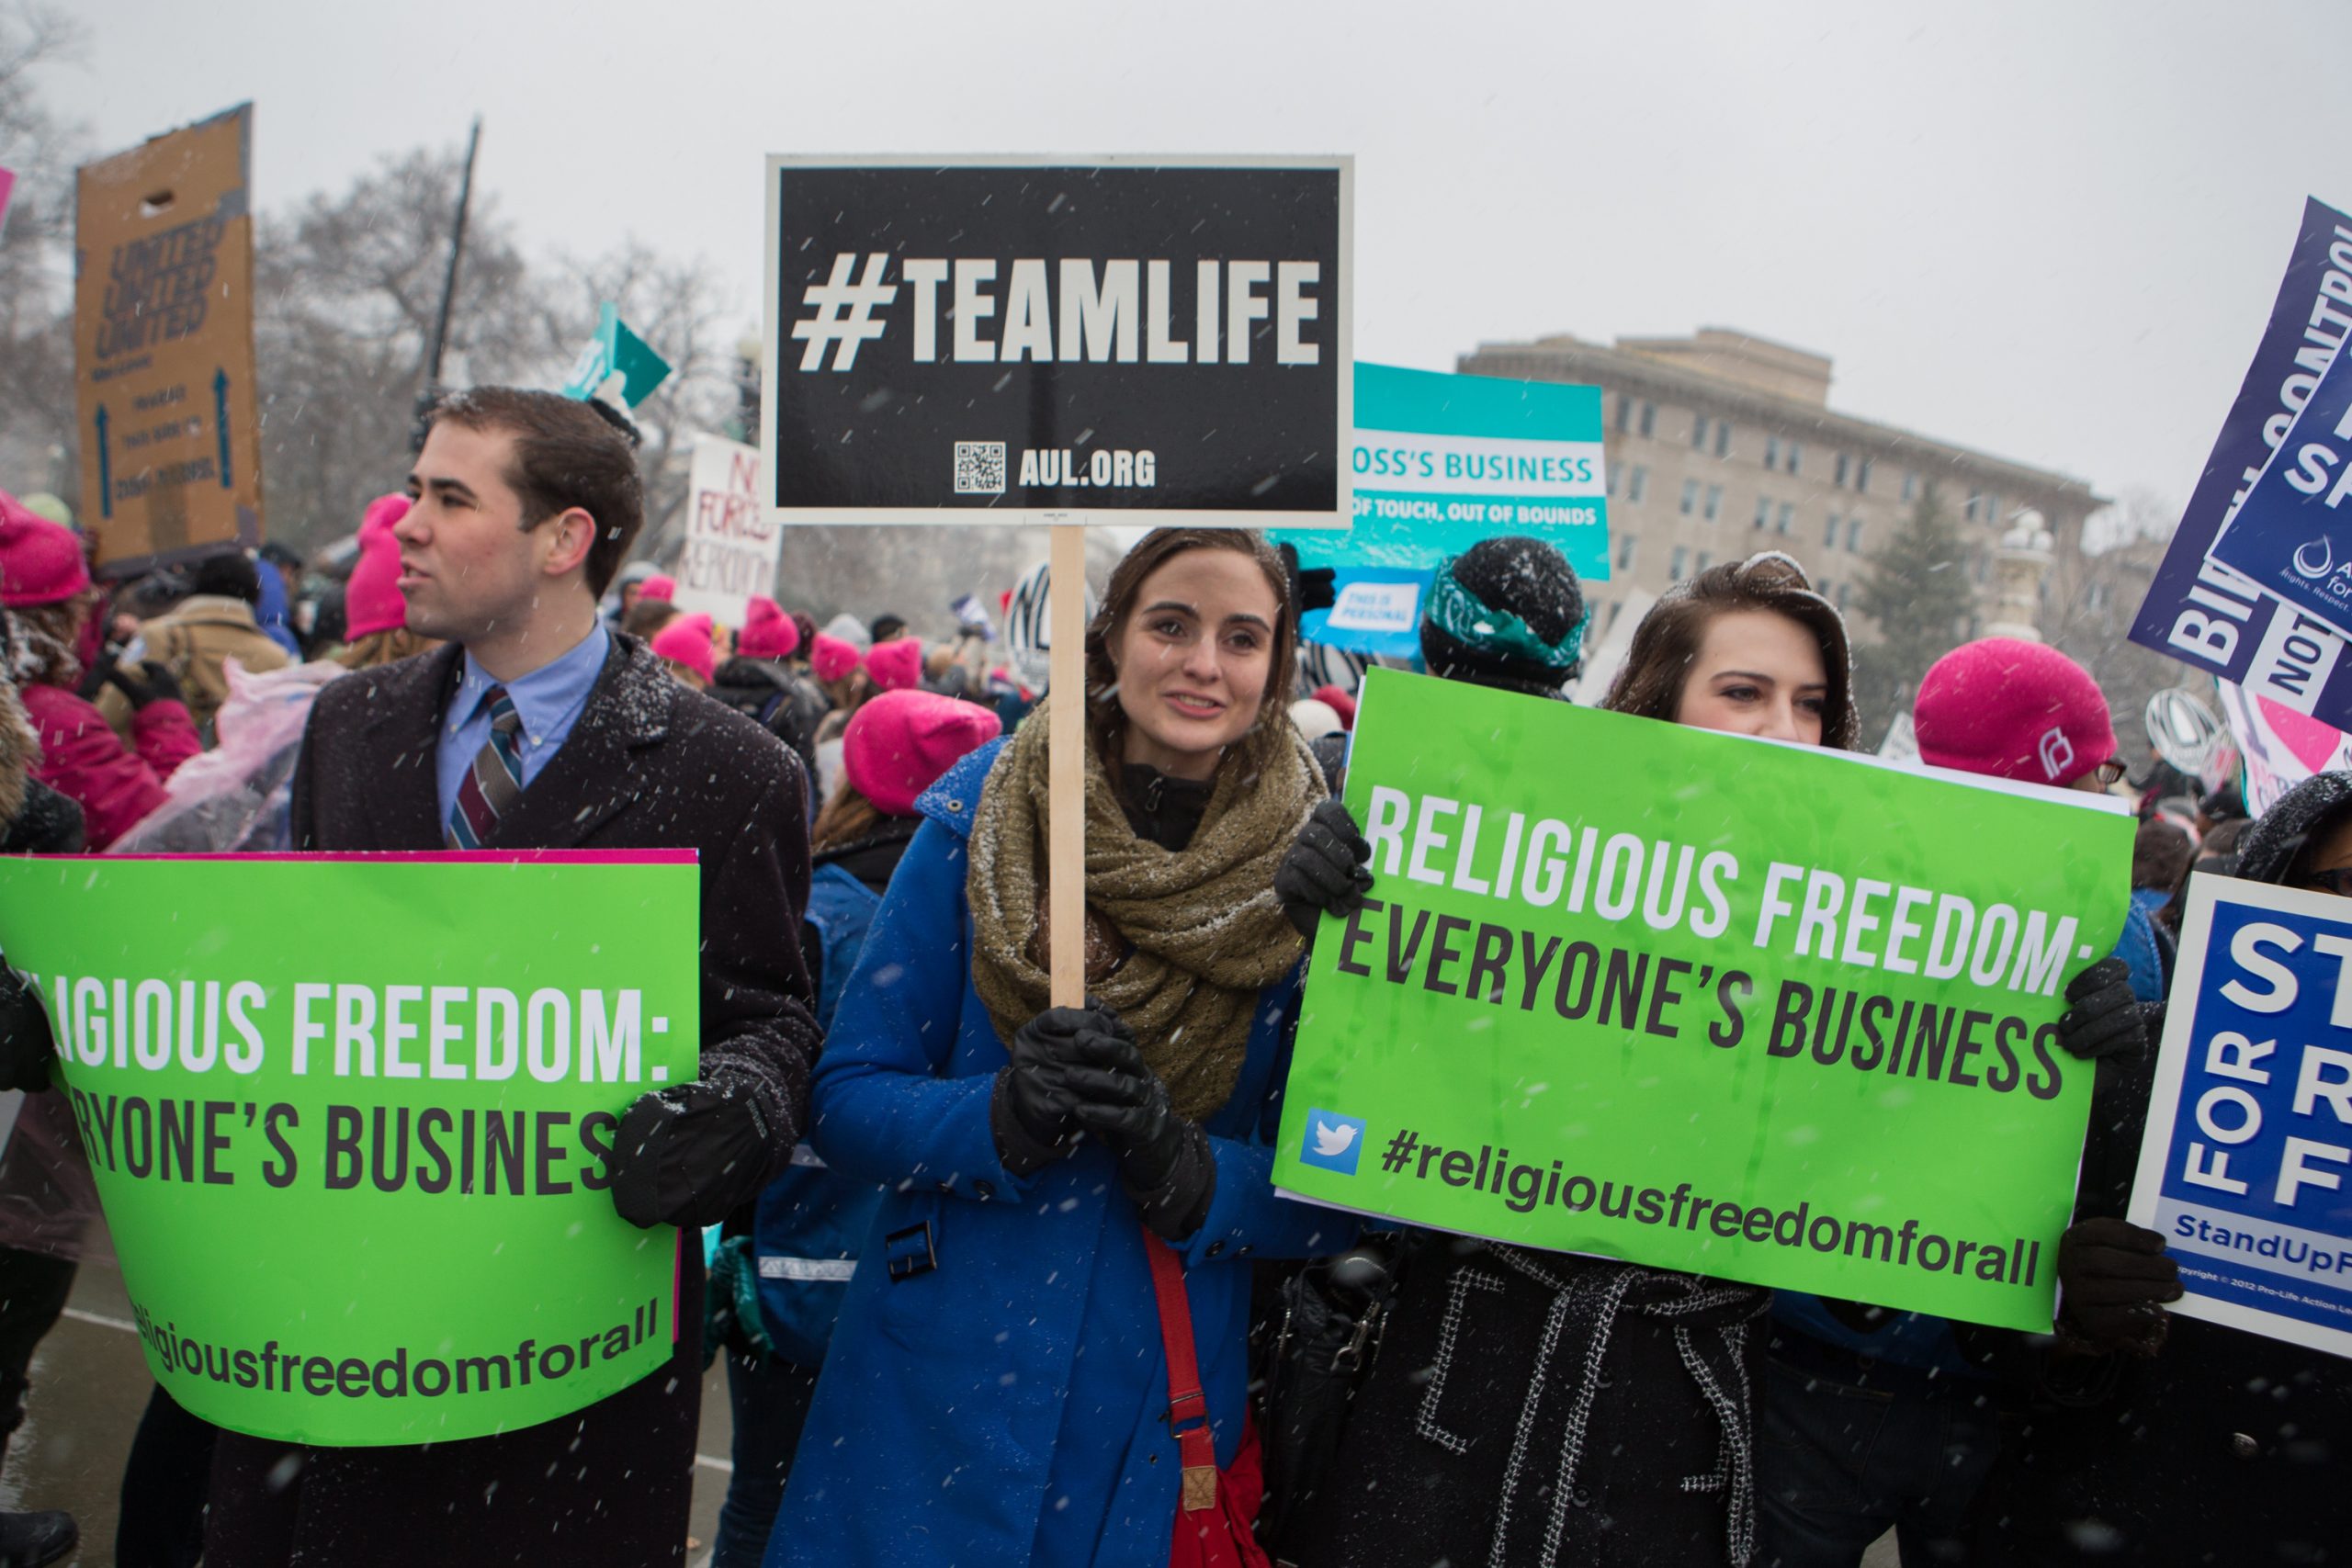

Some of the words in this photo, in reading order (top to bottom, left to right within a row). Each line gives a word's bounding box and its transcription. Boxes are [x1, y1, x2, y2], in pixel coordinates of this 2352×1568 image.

[96, 294, 208, 359] UNITED
[791, 252, 1320, 371] #TEAMLIFE
[1019, 449, 1156, 487] AUL.ORG
[1353, 446, 1434, 478] OSS'S
[1445, 454, 1593, 483] BUSINESS
[1353, 499, 1374, 517] OF
[1374, 501, 1446, 524] TOUCH,
[1448, 502, 1486, 521] OUT
[1488, 504, 1514, 523] OF
[1517, 505, 1598, 526] BOUNDS
[1361, 785, 1740, 941] RELIGIOUS
[290, 982, 669, 1084] FREEDOM:
[1338, 897, 1754, 1048] EVERYONE'S
[1766, 979, 2064, 1100] BUSINESS
[323, 1104, 619, 1196] BUSINES
[2183, 1031, 2277, 1196] FOR
[1381, 1128, 2041, 1287] #religiousfreedomforall
[2230, 1278, 2256, 1292] 2012
[2256, 1285, 2300, 1302] Pro-Life
[2301, 1296, 2337, 1312] Action
